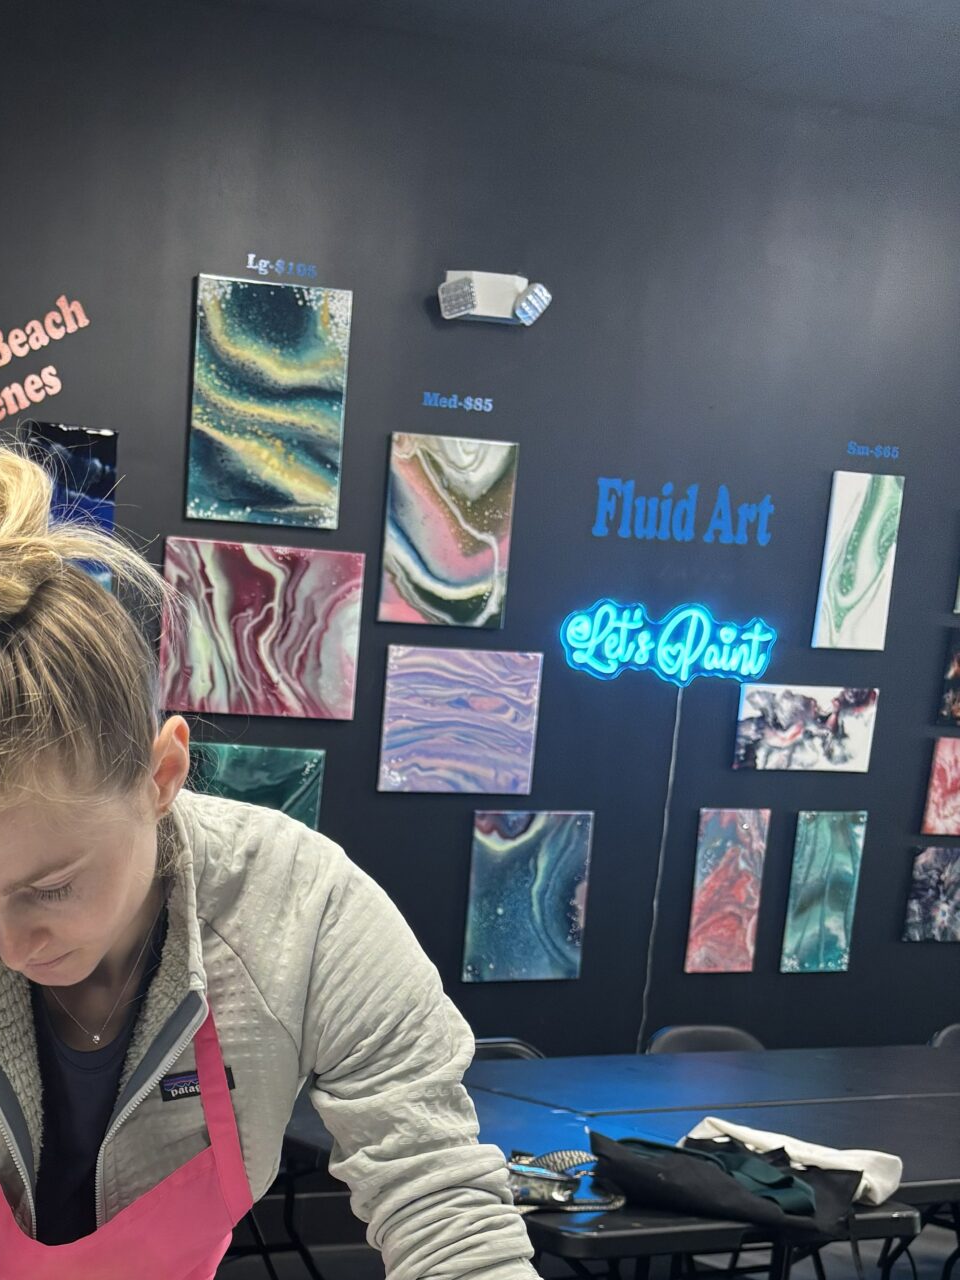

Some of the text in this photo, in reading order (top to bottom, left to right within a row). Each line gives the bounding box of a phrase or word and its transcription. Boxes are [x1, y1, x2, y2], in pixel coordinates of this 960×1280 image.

[422, 391, 494, 413] Med-$85
[591, 476, 776, 547] Fluid Art
[565, 602, 775, 683] Let's Paint
